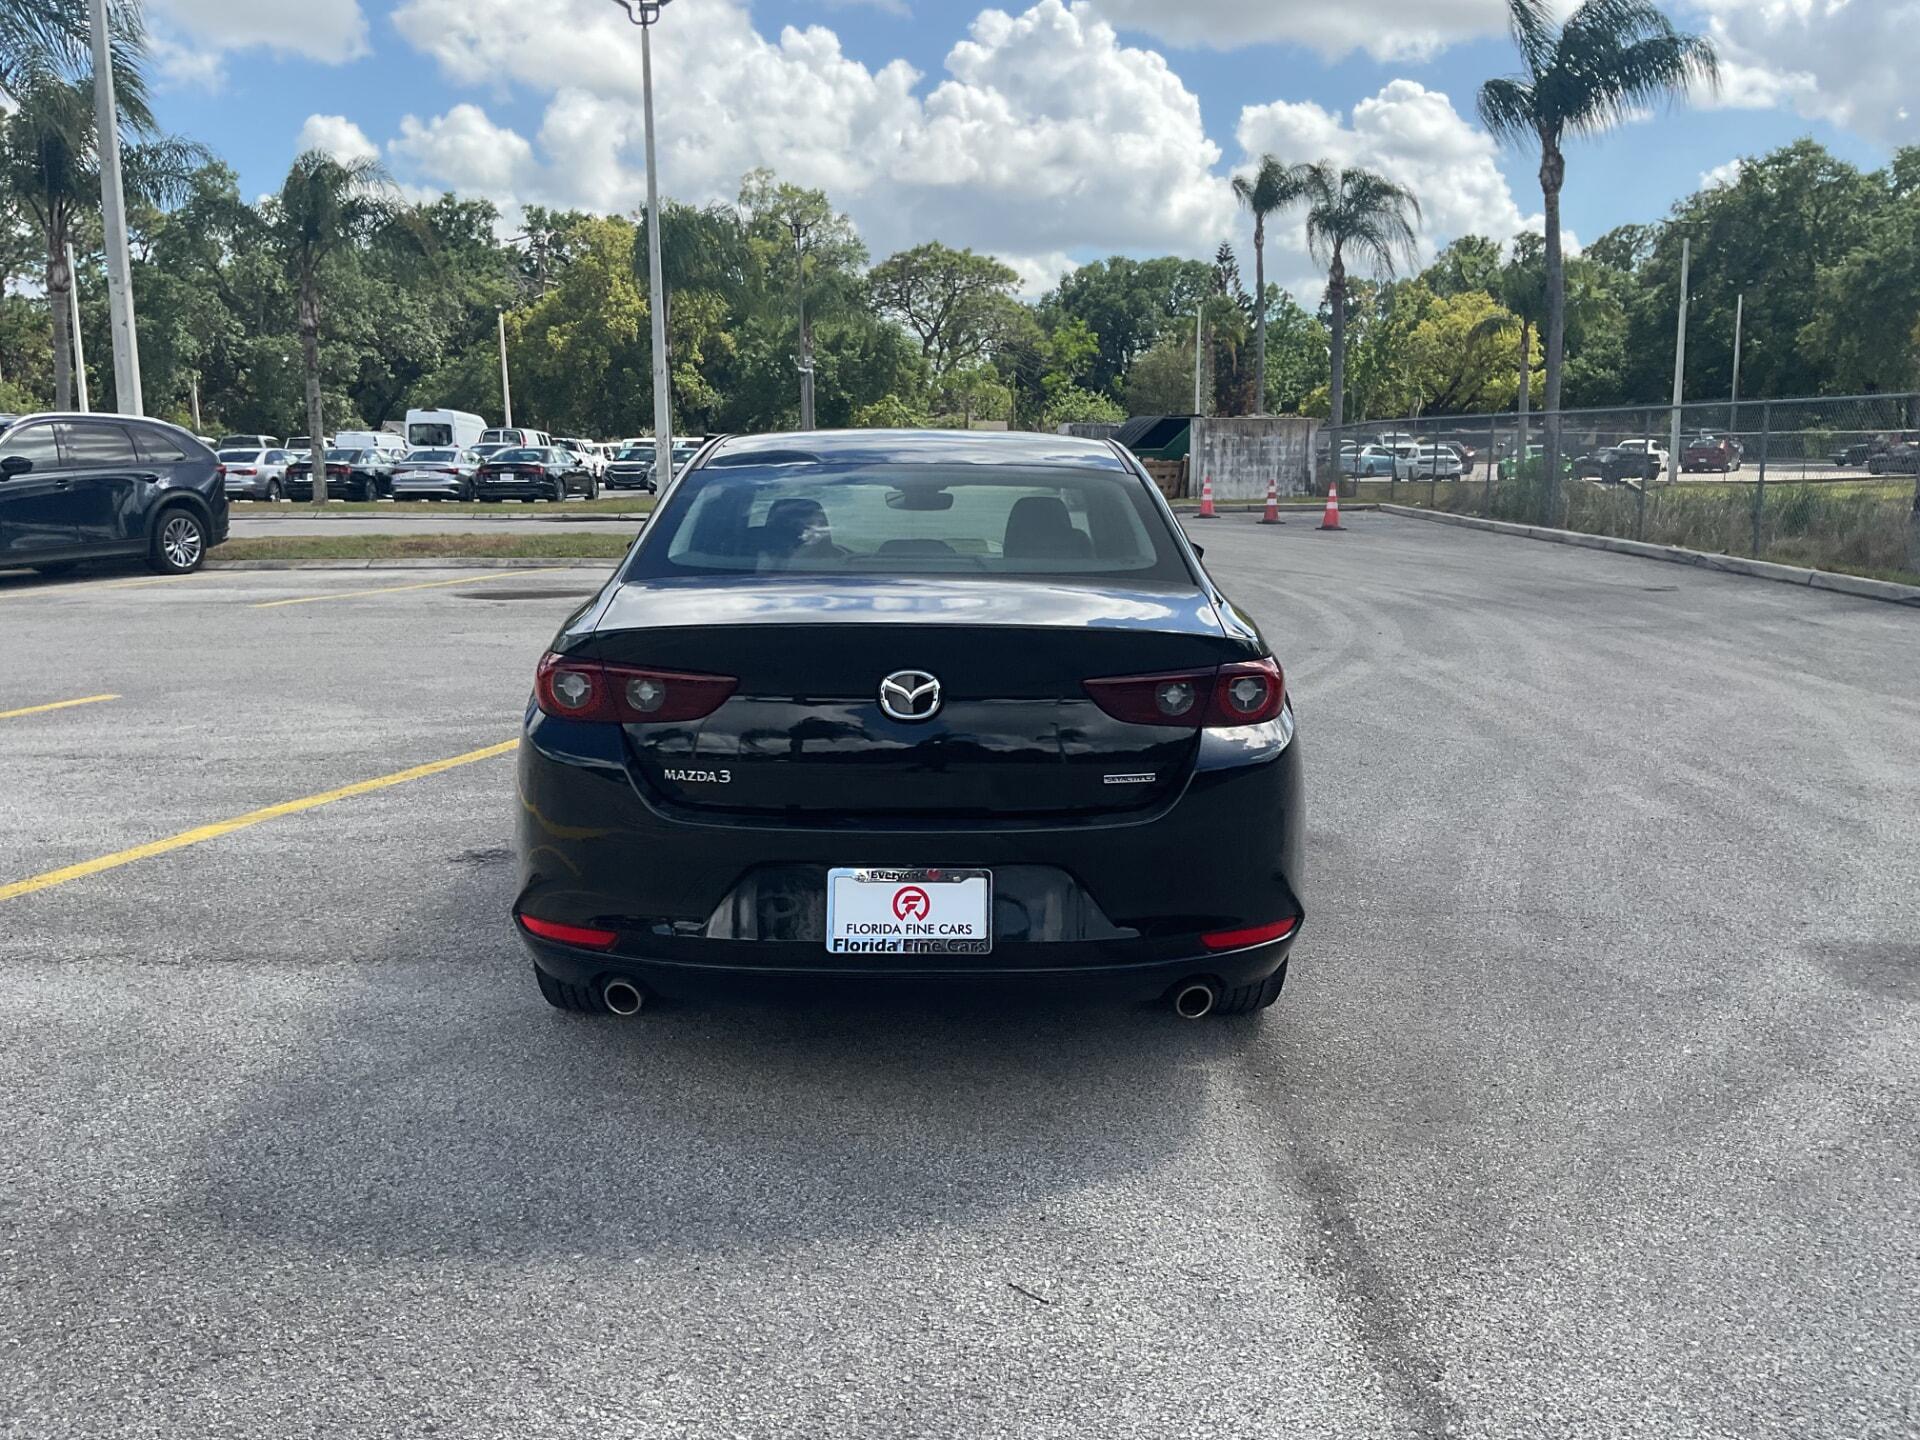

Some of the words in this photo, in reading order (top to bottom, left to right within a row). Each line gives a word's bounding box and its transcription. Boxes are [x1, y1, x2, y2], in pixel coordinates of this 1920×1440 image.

[846, 923, 901, 935] FLORIDA
[905, 923, 935, 935] FINE
[938, 923, 972, 935] CARS
[833, 938, 897, 952] Florida
[902, 938, 942, 953] Fine
[946, 938, 986, 953] Cars
